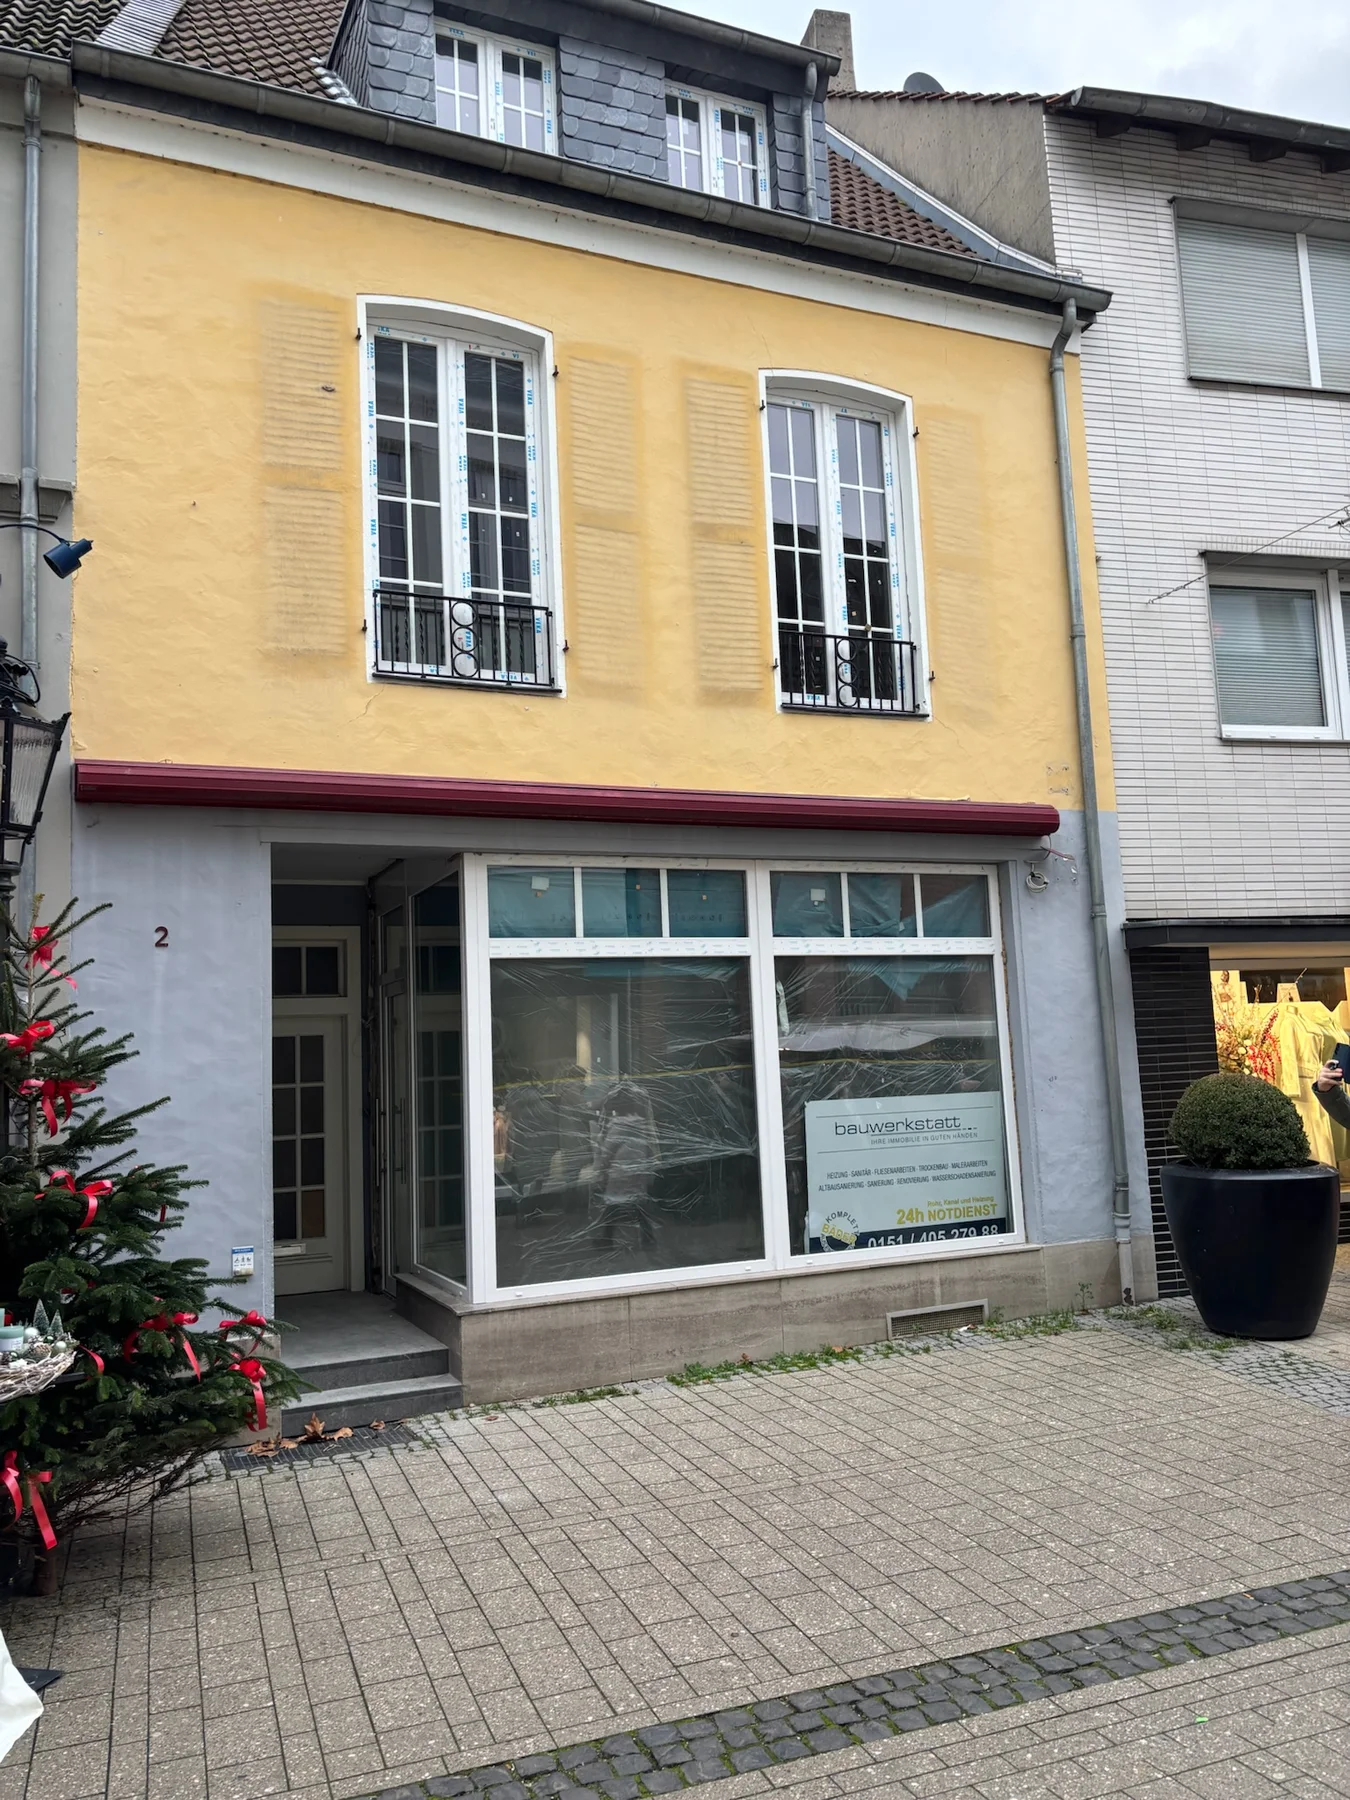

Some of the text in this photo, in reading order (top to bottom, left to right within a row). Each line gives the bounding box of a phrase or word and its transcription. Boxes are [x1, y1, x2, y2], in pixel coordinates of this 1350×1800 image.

[154, 926, 169, 948] 2
[888, 1136, 920, 1144] IMMOBILIE
[952, 1131, 978, 1139] HÄNDEN
[826, 1171, 848, 1179] HEIZUNG
[874, 1165, 916, 1175] FLIESENARBEITEN
[919, 1163, 949, 1172] TROCKENBAU
[951, 1160, 988, 1169] MALERARBEITEN
[818, 1181, 865, 1192] ALTBAUSANIERUNG
[867, 1178, 895, 1187] SANIERUNG
[897, 1175, 929, 1185] RENOVIERUNG
[896, 1203, 998, 1225] 24h NOTDIENST
